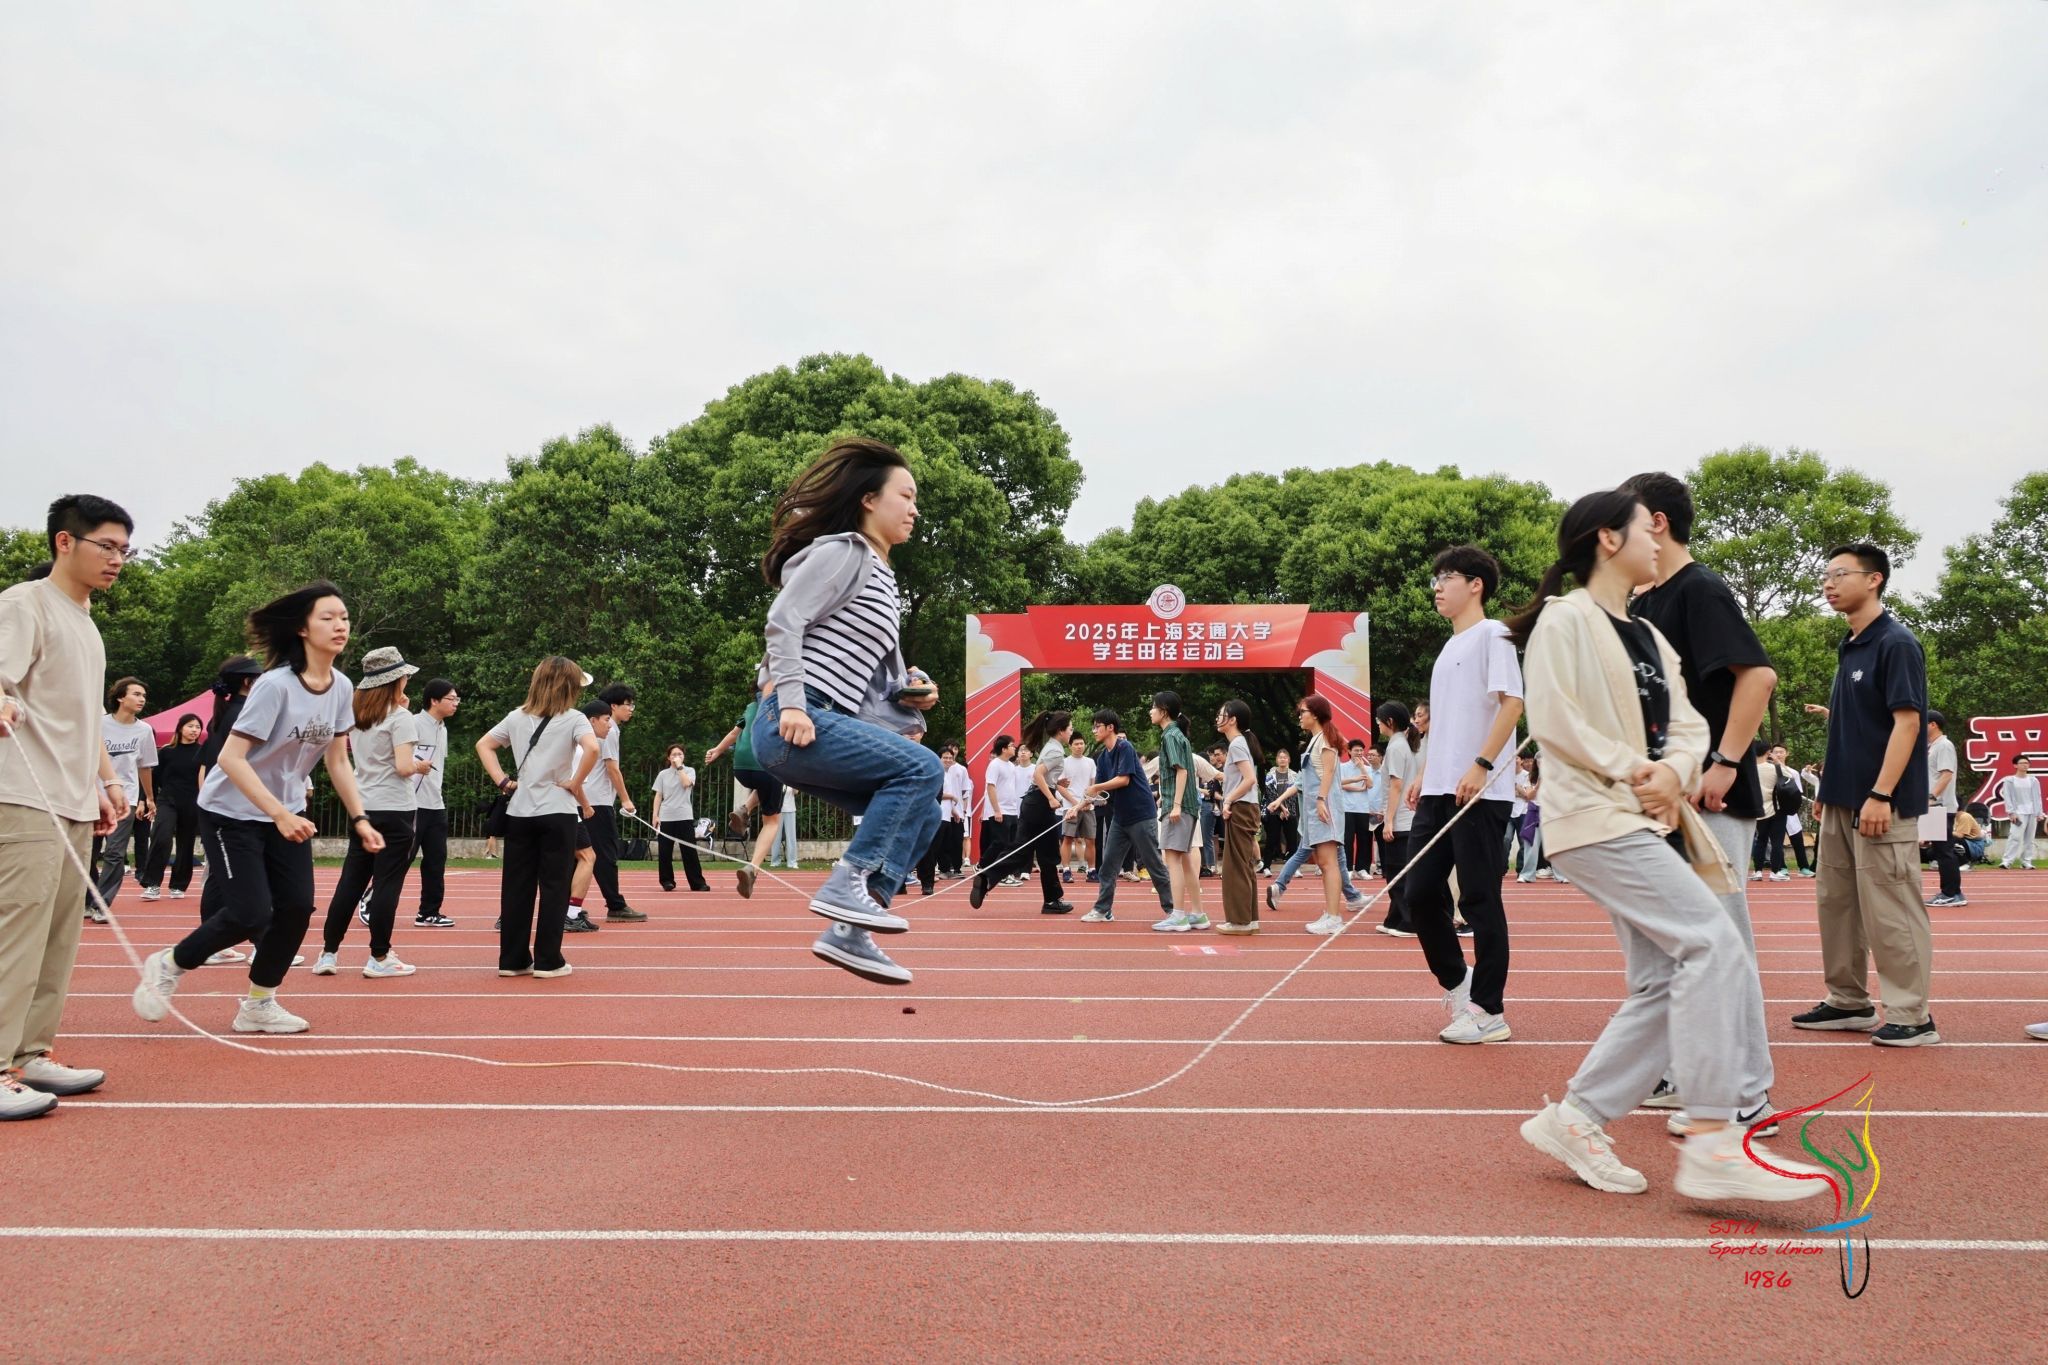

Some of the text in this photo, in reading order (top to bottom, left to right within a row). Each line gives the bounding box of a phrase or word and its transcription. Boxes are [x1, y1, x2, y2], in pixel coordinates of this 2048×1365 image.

[1065, 622, 1271, 641] 2025年上海交通大学
[1093, 643, 1245, 661] 学生田径运动会
[104, 737, 139, 751] Russell
